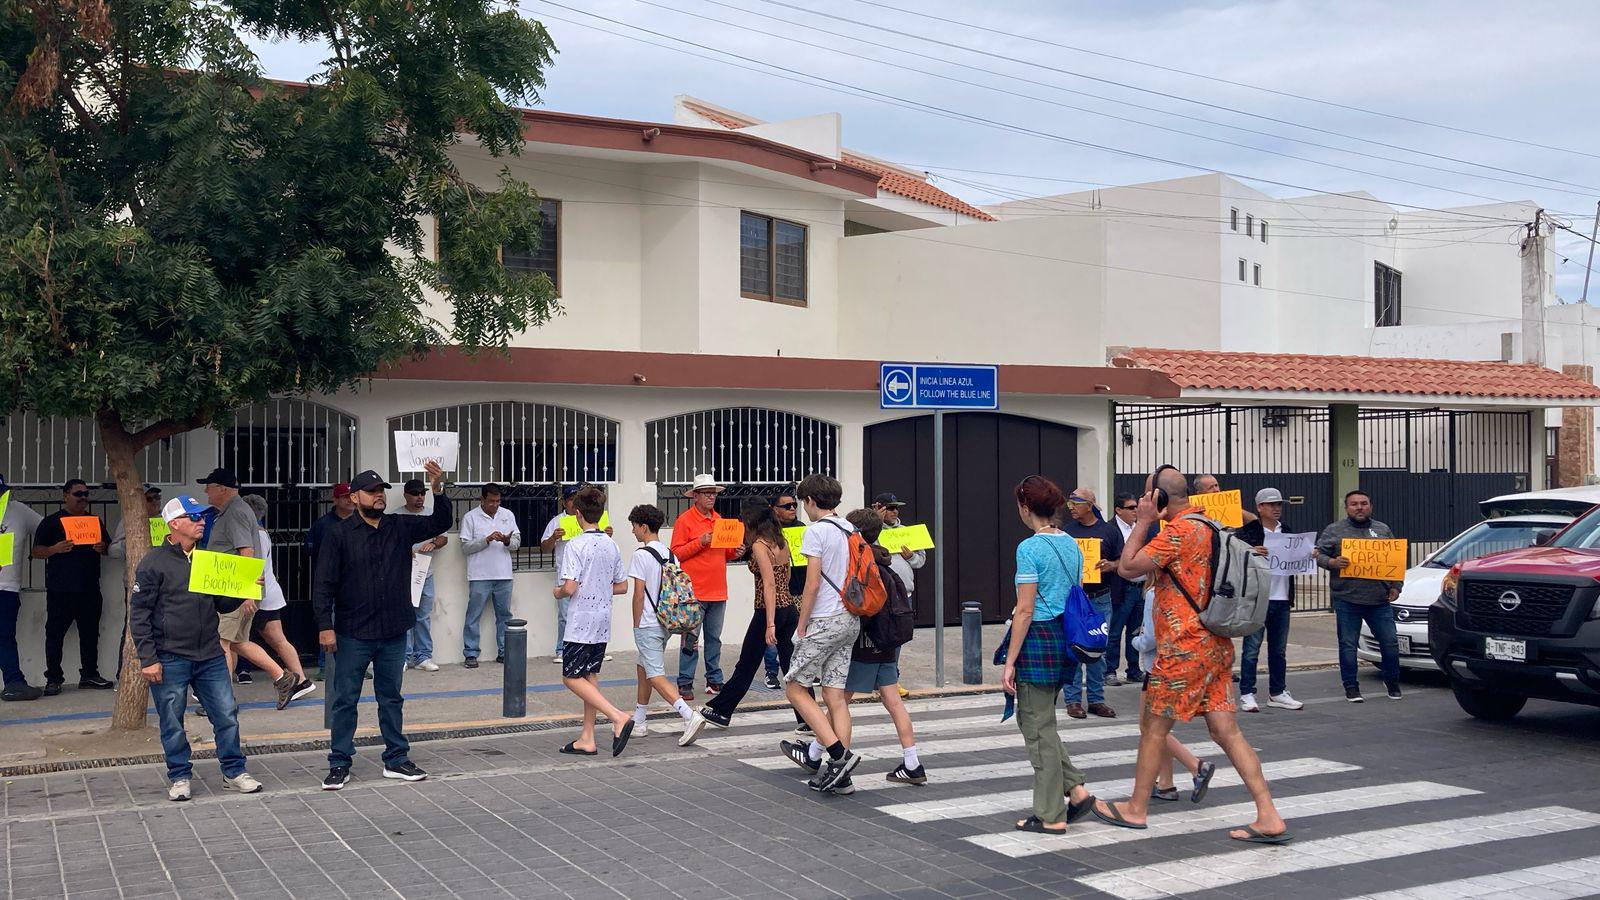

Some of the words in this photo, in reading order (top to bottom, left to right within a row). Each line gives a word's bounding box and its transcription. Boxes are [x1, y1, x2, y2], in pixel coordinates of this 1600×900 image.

[920, 377, 938, 386] INICIA
[939, 377, 957, 386] LINEA
[958, 378, 973, 386] AZUL
[920, 389, 945, 398] FOLLOW
[946, 390, 959, 398] THE
[960, 390, 977, 399] BLUE
[978, 391, 991, 399] LINE
[1343, 540, 1402, 551] WELCOME
[1351, 551, 1389, 564] CARLY
